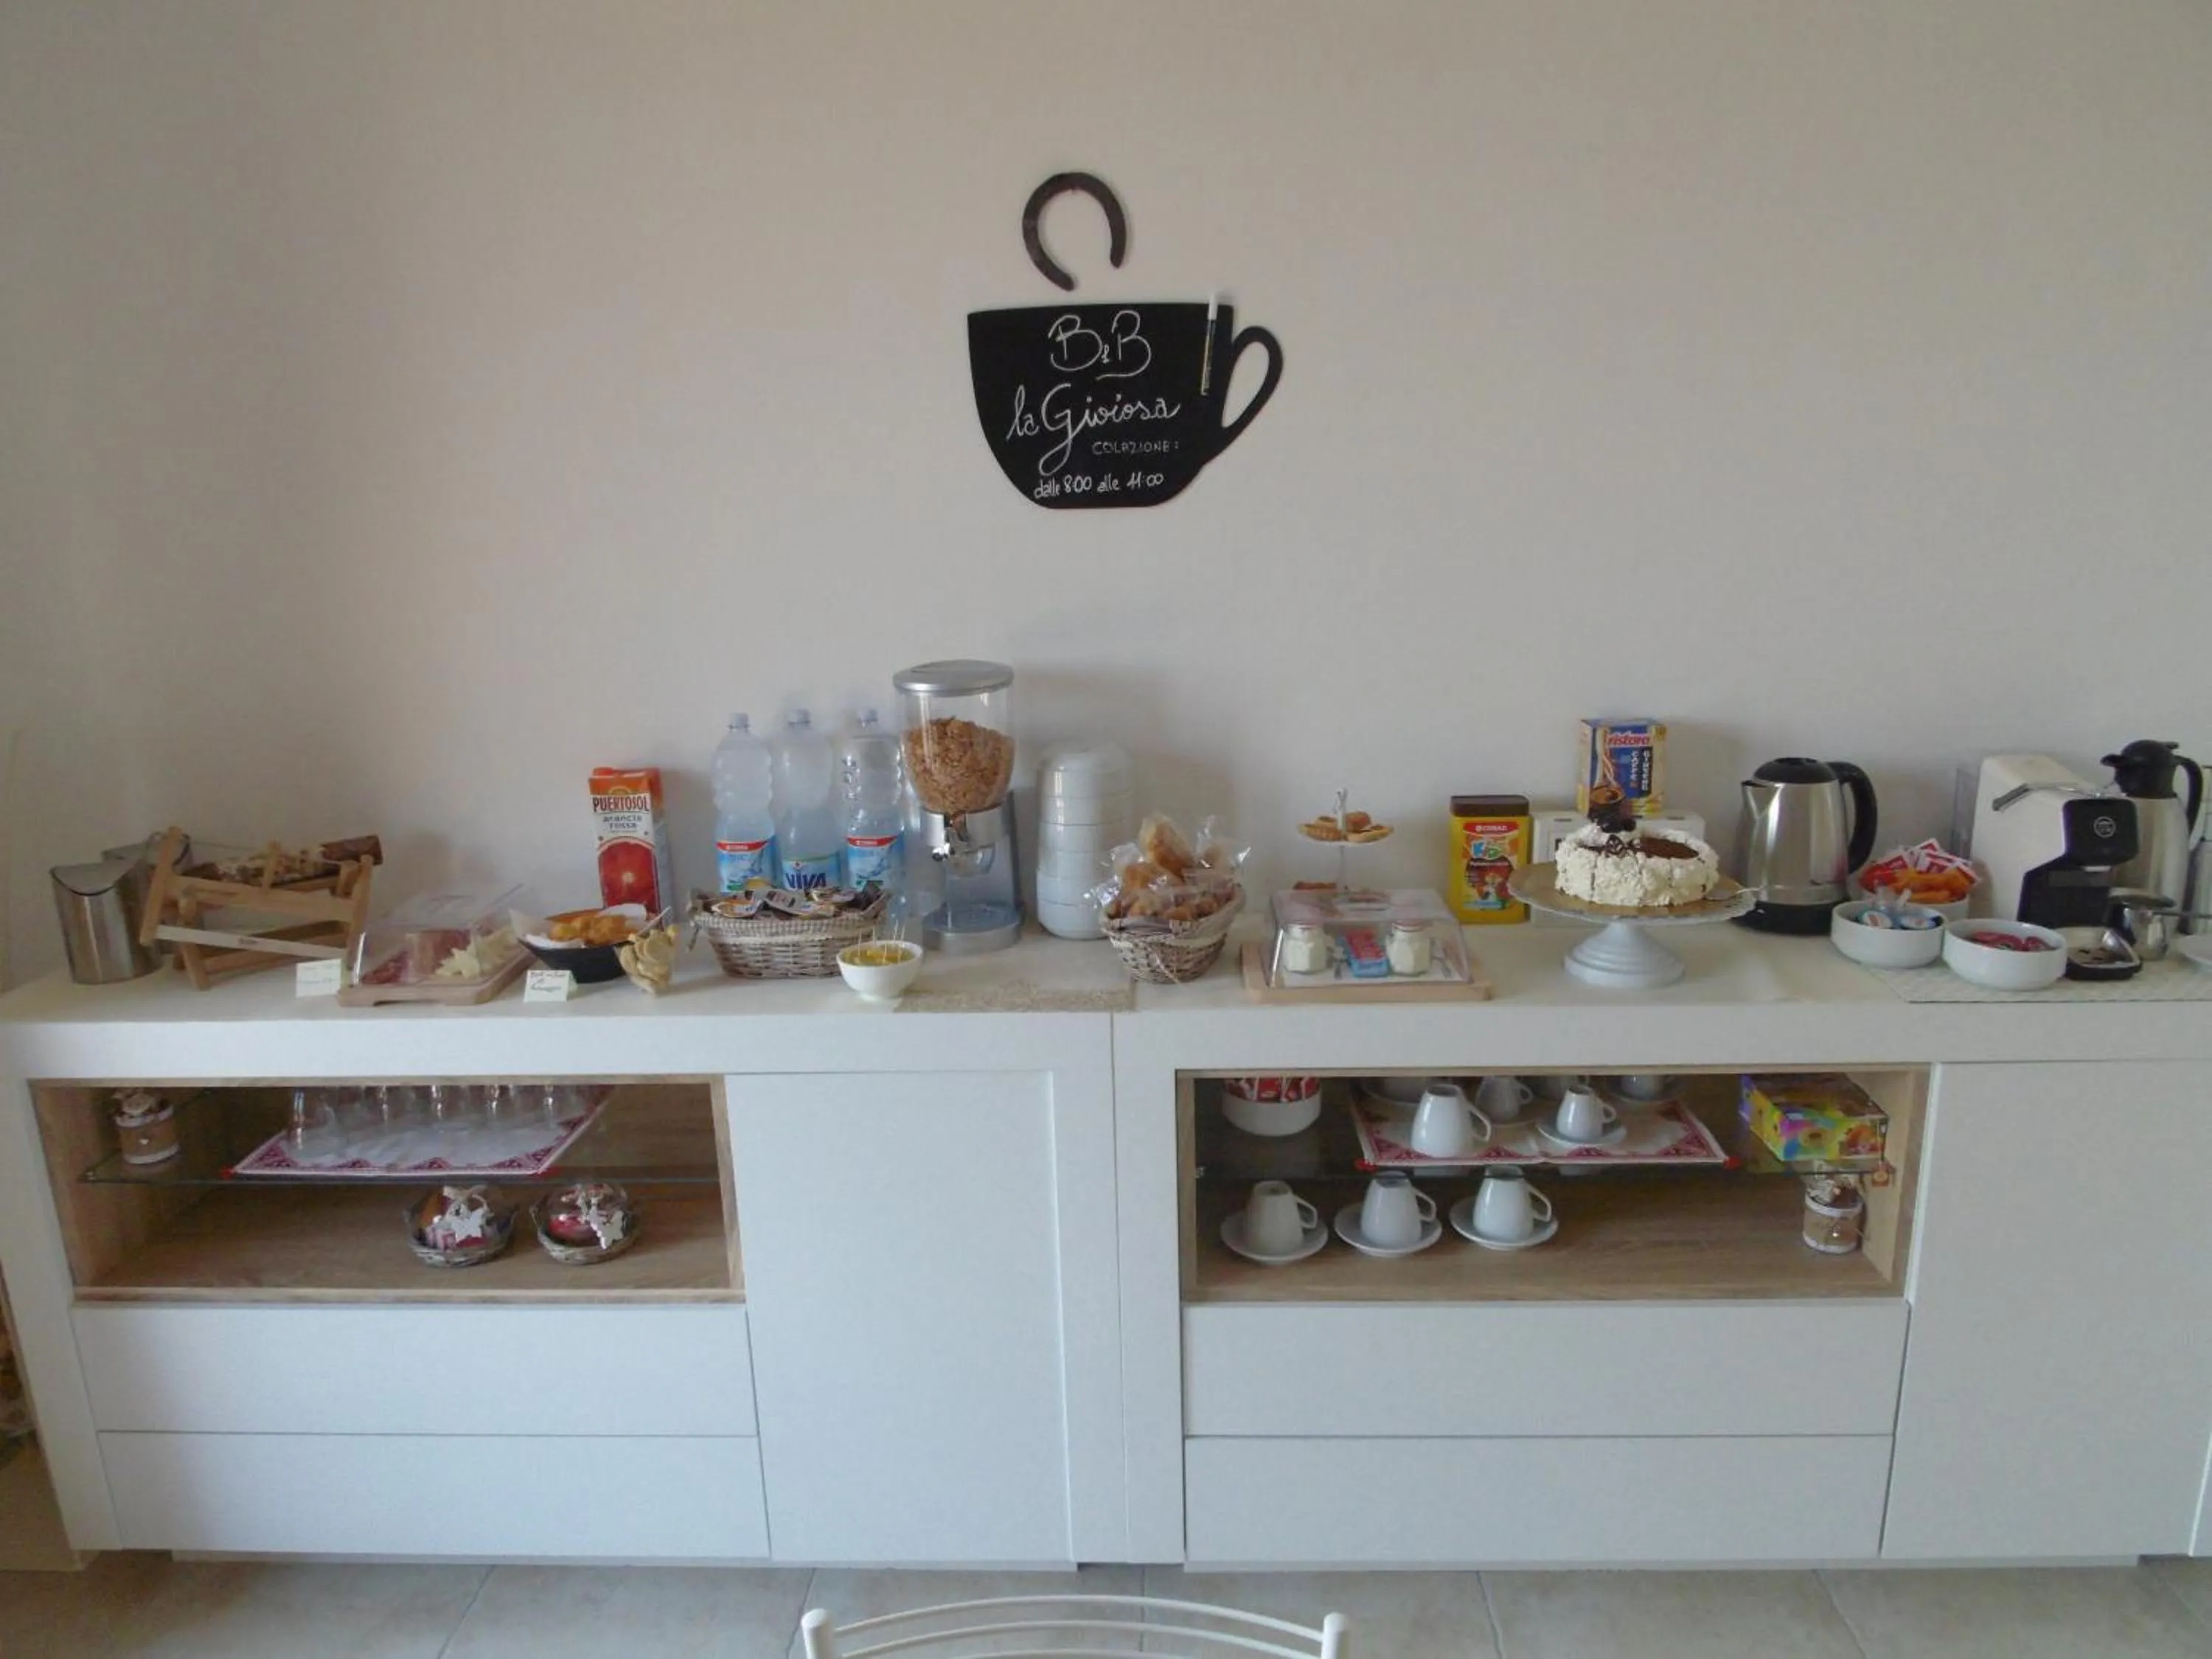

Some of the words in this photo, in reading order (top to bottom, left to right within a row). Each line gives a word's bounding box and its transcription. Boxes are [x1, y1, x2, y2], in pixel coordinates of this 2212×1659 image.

[1048, 310, 1152, 380] B&B
[1040, 383, 1181, 476] Gioiosa
[1034, 478, 1061, 499] dalle
[1097, 473, 1121, 493] alle
[593, 796, 649, 813] PUERTOSOL
